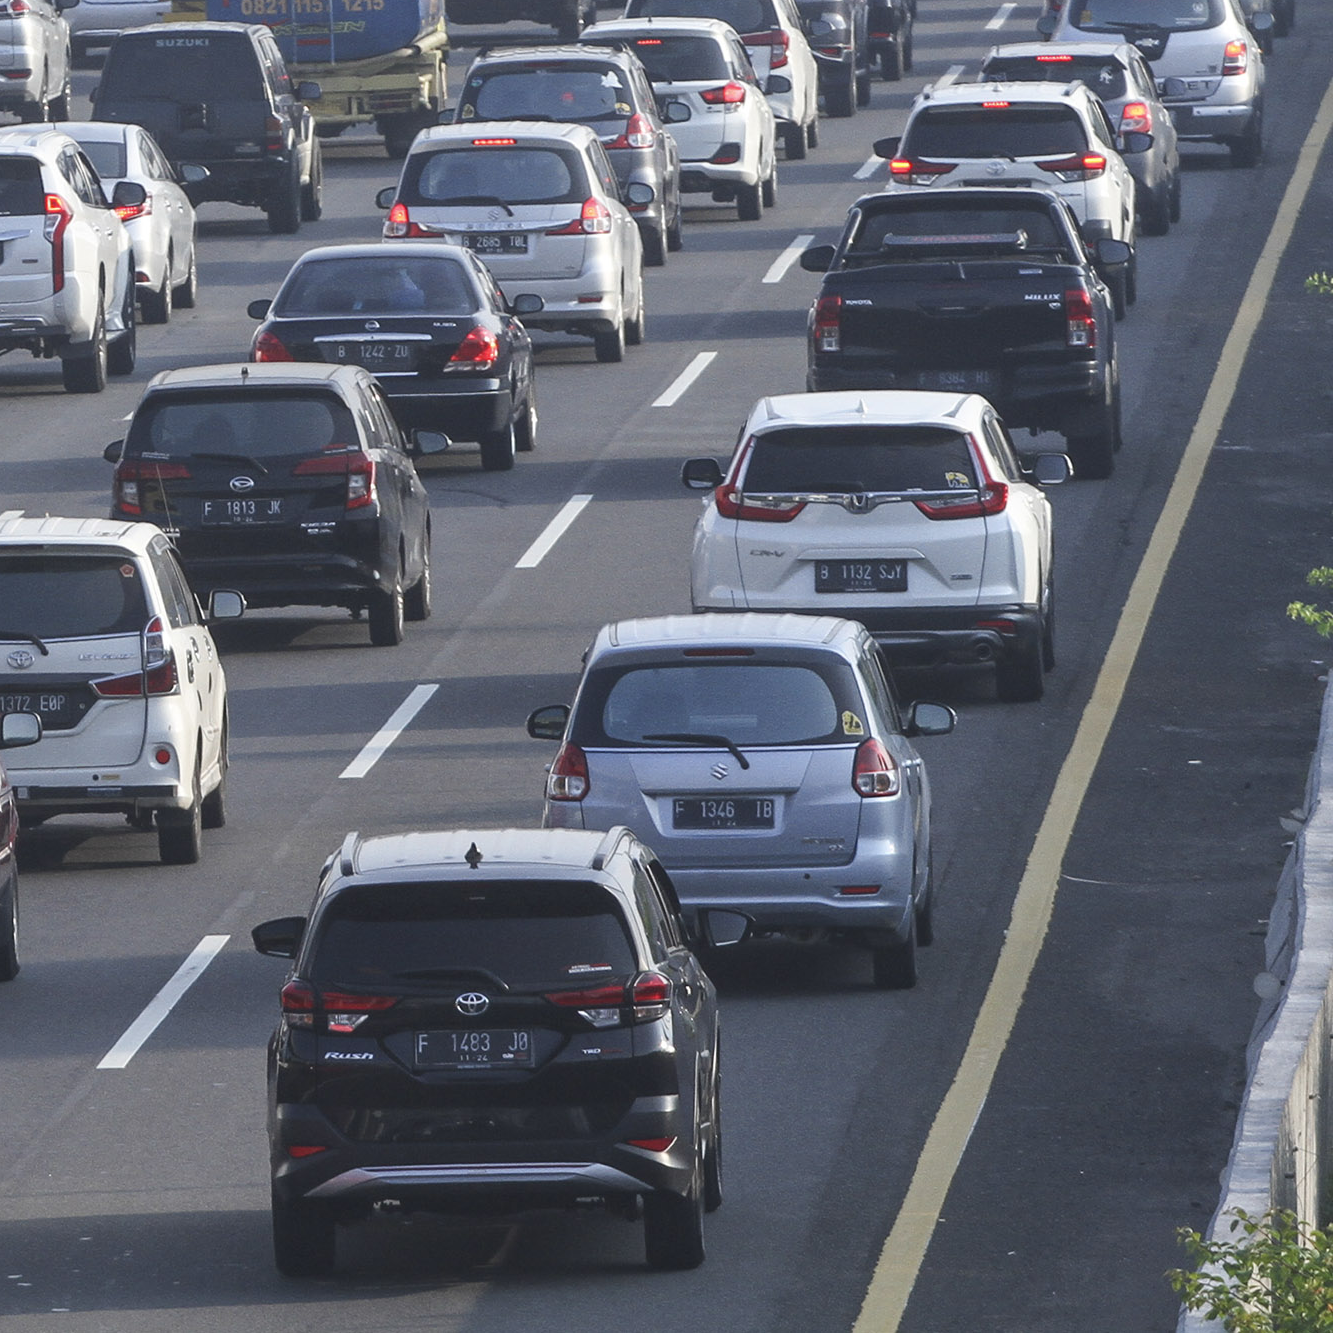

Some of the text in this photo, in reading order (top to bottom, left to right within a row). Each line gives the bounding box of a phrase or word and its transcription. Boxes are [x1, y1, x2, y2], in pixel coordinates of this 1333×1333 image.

[156, 38, 210, 47] SUZUKI
[338, 346, 345, 357] B
[360, 345, 385, 357] 1242
[204, 500, 281, 516] F 1813 JK
[821, 567, 828, 578] B
[843, 564, 871, 580] 1132
[0, 695, 31, 711] 1372
[675, 801, 684, 814] F
[700, 800, 735, 817] 1346
[418, 1034, 428, 1052] F
[450, 1032, 491, 1051] 1483
[323, 1051, 374, 1060] Rush
